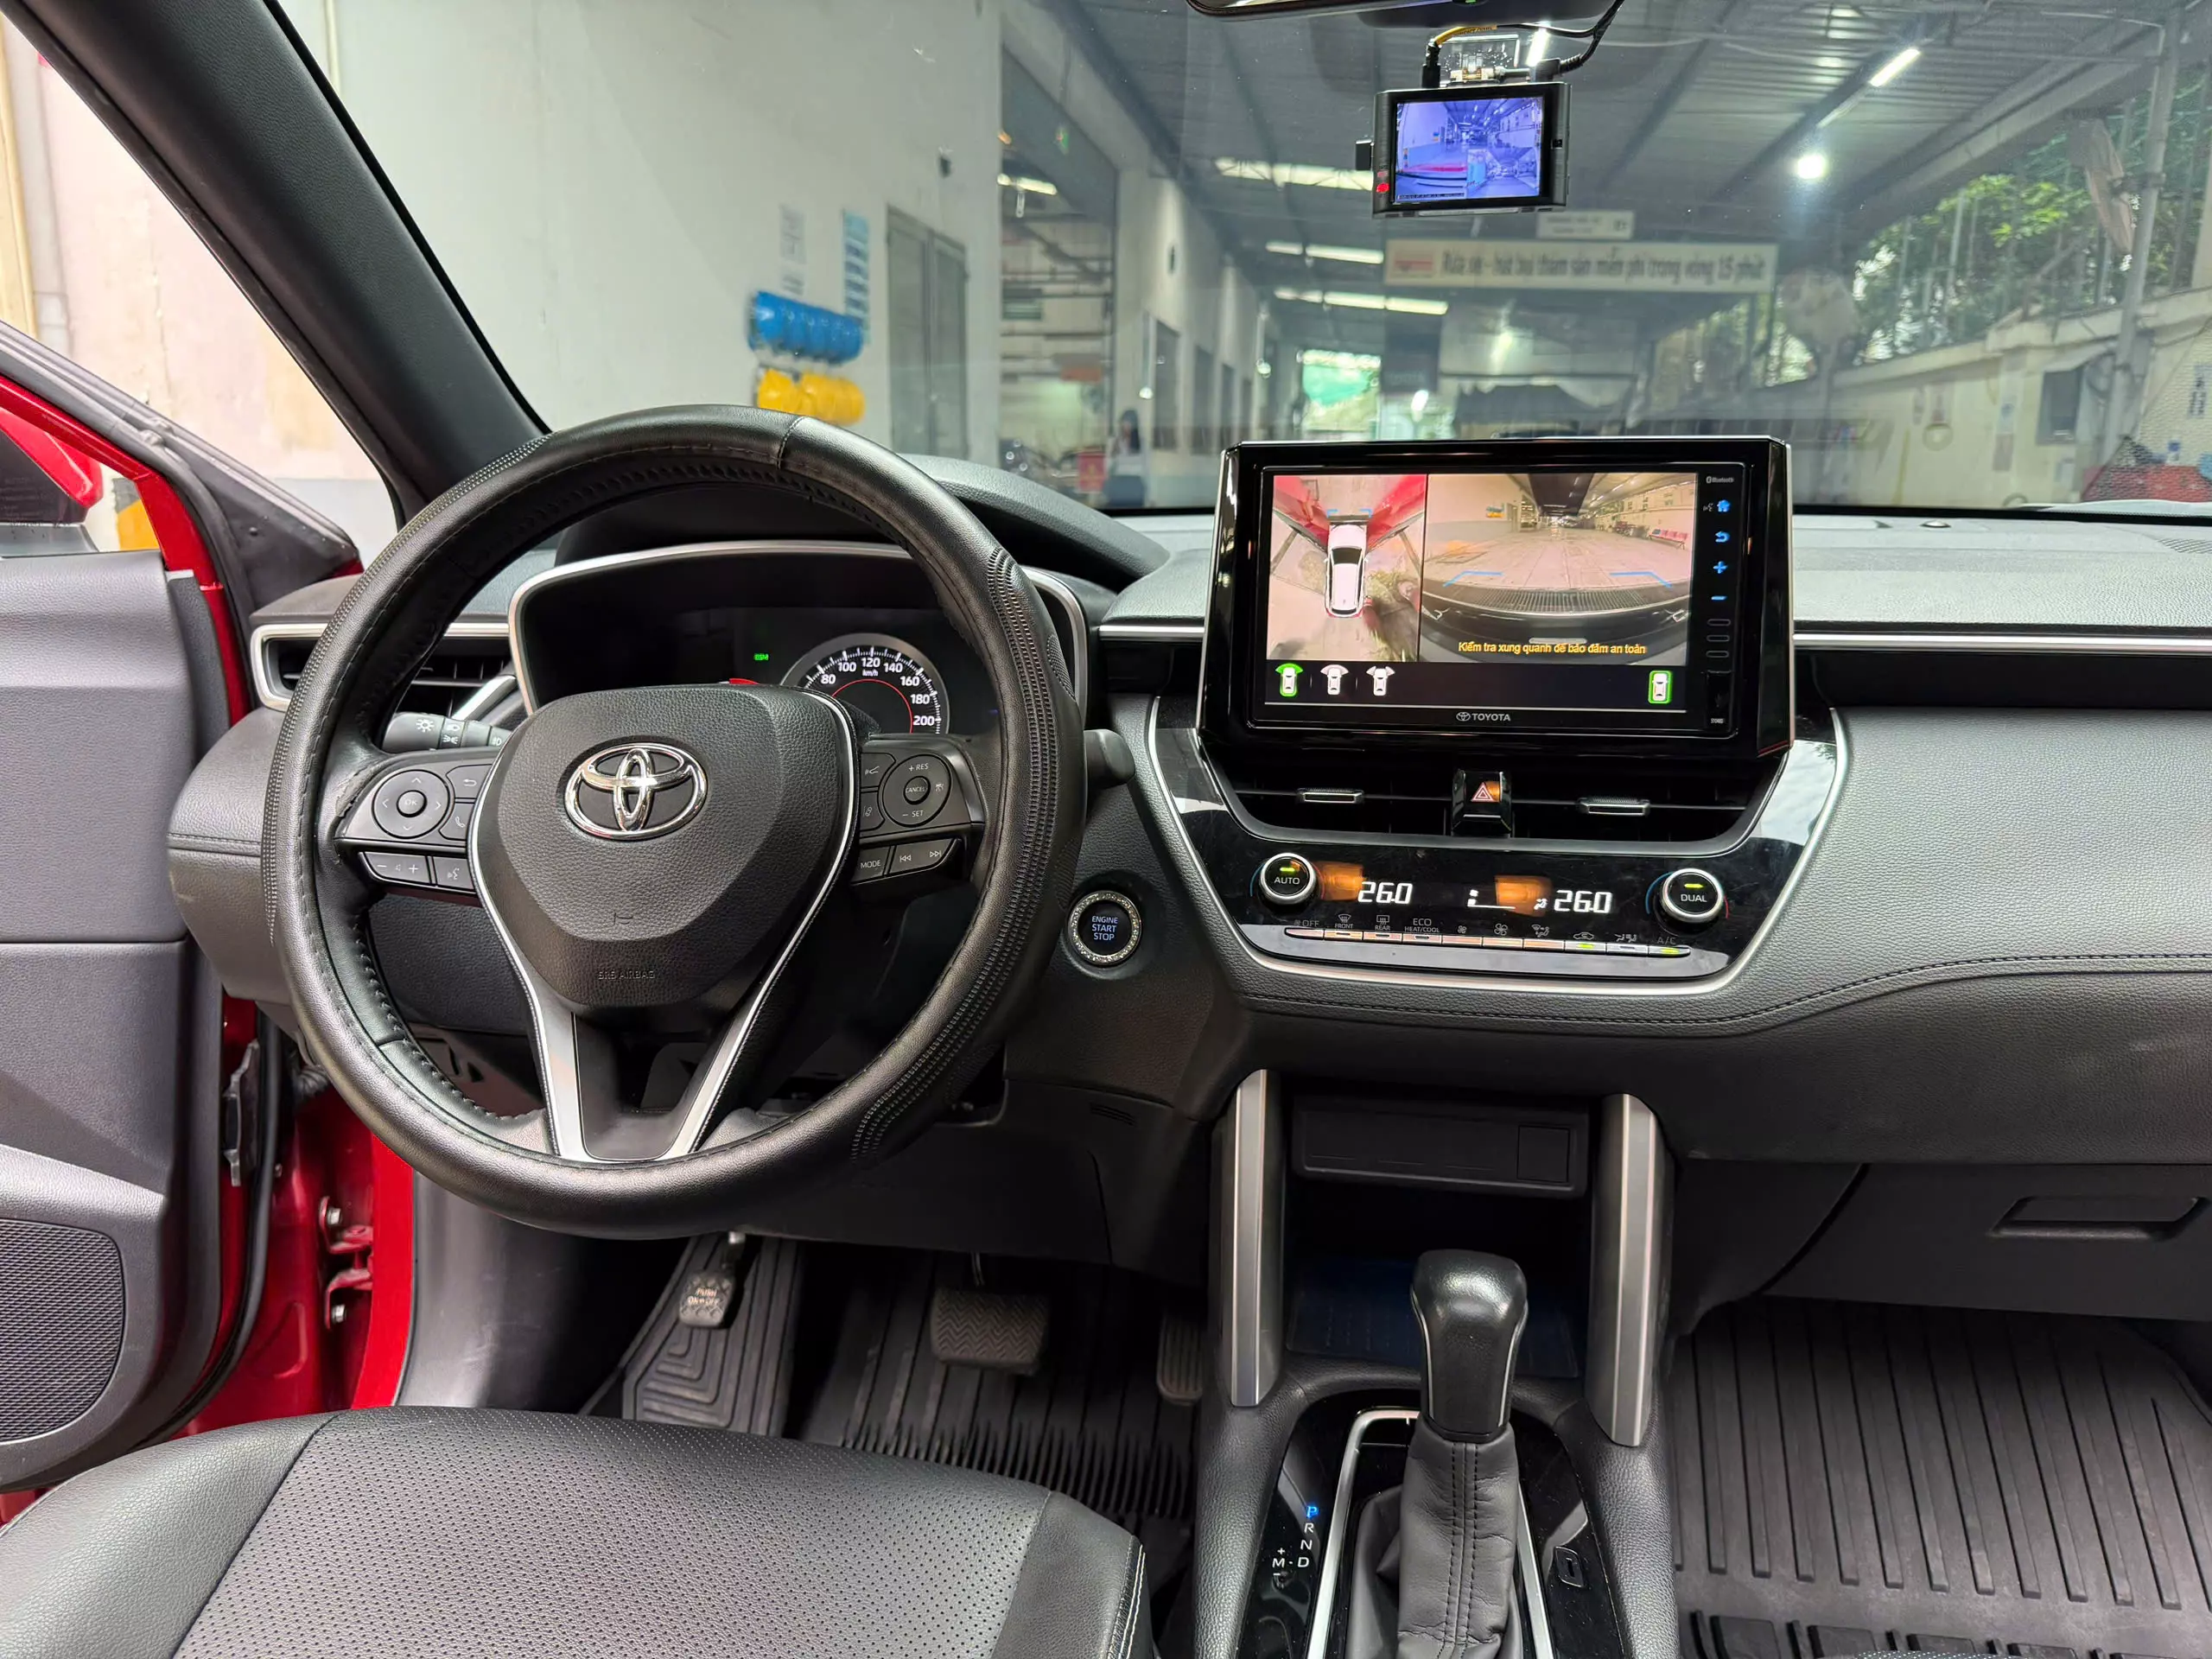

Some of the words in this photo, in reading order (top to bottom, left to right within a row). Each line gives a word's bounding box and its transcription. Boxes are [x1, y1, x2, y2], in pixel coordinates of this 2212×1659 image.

[1458, 641, 1482, 652] Kiểm
[1484, 642, 1497, 652] tra
[1498, 644, 1521, 655] xung
[1522, 644, 1552, 655] quanh
[1611, 645, 1623, 654] an
[837, 661, 857, 672] 100
[861, 657, 880, 669] 120
[883, 662, 904, 673] 140
[820, 674, 836, 685] 80
[899, 676, 920, 687] 160
[910, 693, 931, 705] 180
[912, 715, 935, 726] 200
[1471, 713, 1511, 721] TOYOTA
[916, 762, 929, 772] RES
[860, 860, 881, 869] MODE
[1274, 875, 1300, 886] AUTO
[1681, 893, 1707, 903] DUAL
[1302, 919, 1319, 928] OFF
[1413, 918, 1433, 927] ECO
[1091, 924, 1117, 933] START
[1404, 925, 1440, 934] HEAT/COOL
[1093, 932, 1115, 941] STOP
[1657, 935, 1677, 945] A/C
[1306, 1505, 1319, 1519] P
[1304, 1522, 1314, 1534] R
[1300, 1539, 1313, 1550] N
[1272, 1557, 1286, 1568] M
[1297, 1556, 1310, 1568] D
